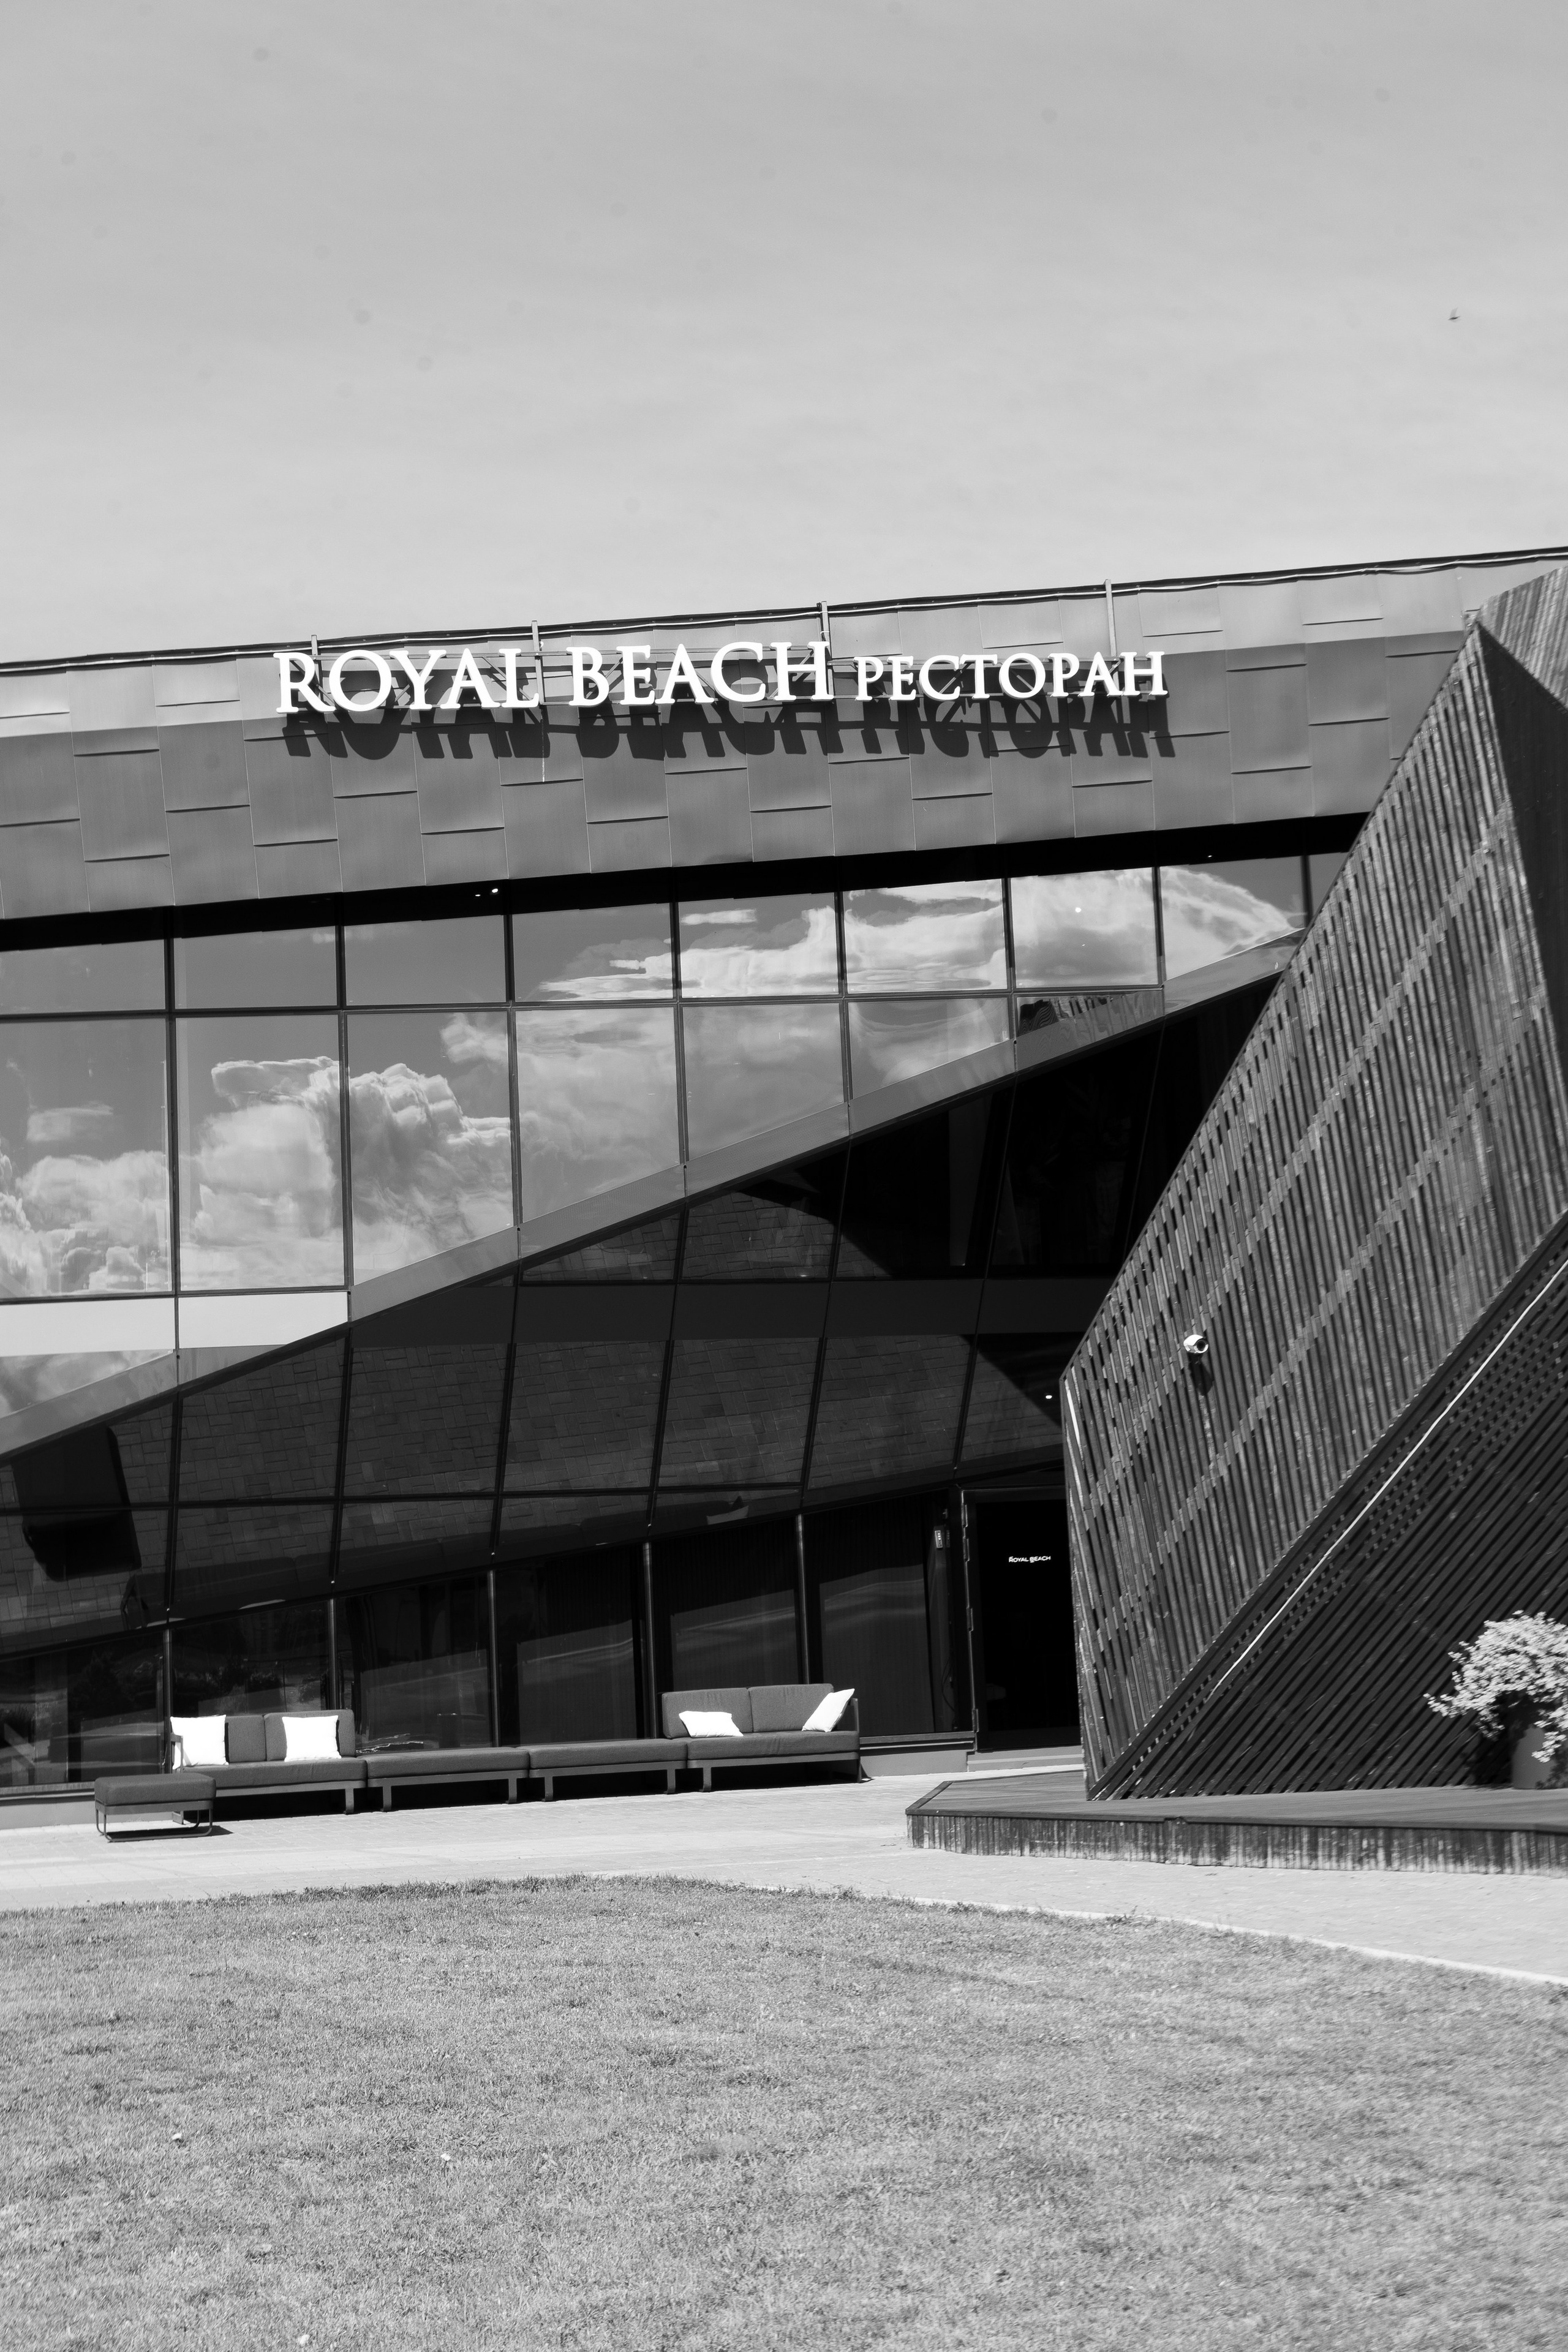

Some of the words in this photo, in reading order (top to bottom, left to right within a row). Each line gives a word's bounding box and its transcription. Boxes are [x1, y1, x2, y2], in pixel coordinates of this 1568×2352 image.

[273, 647, 540, 714] ROYAL
[566, 641, 834, 707] BEACH
[853, 651, 1168, 702] РЕСТОРАН
